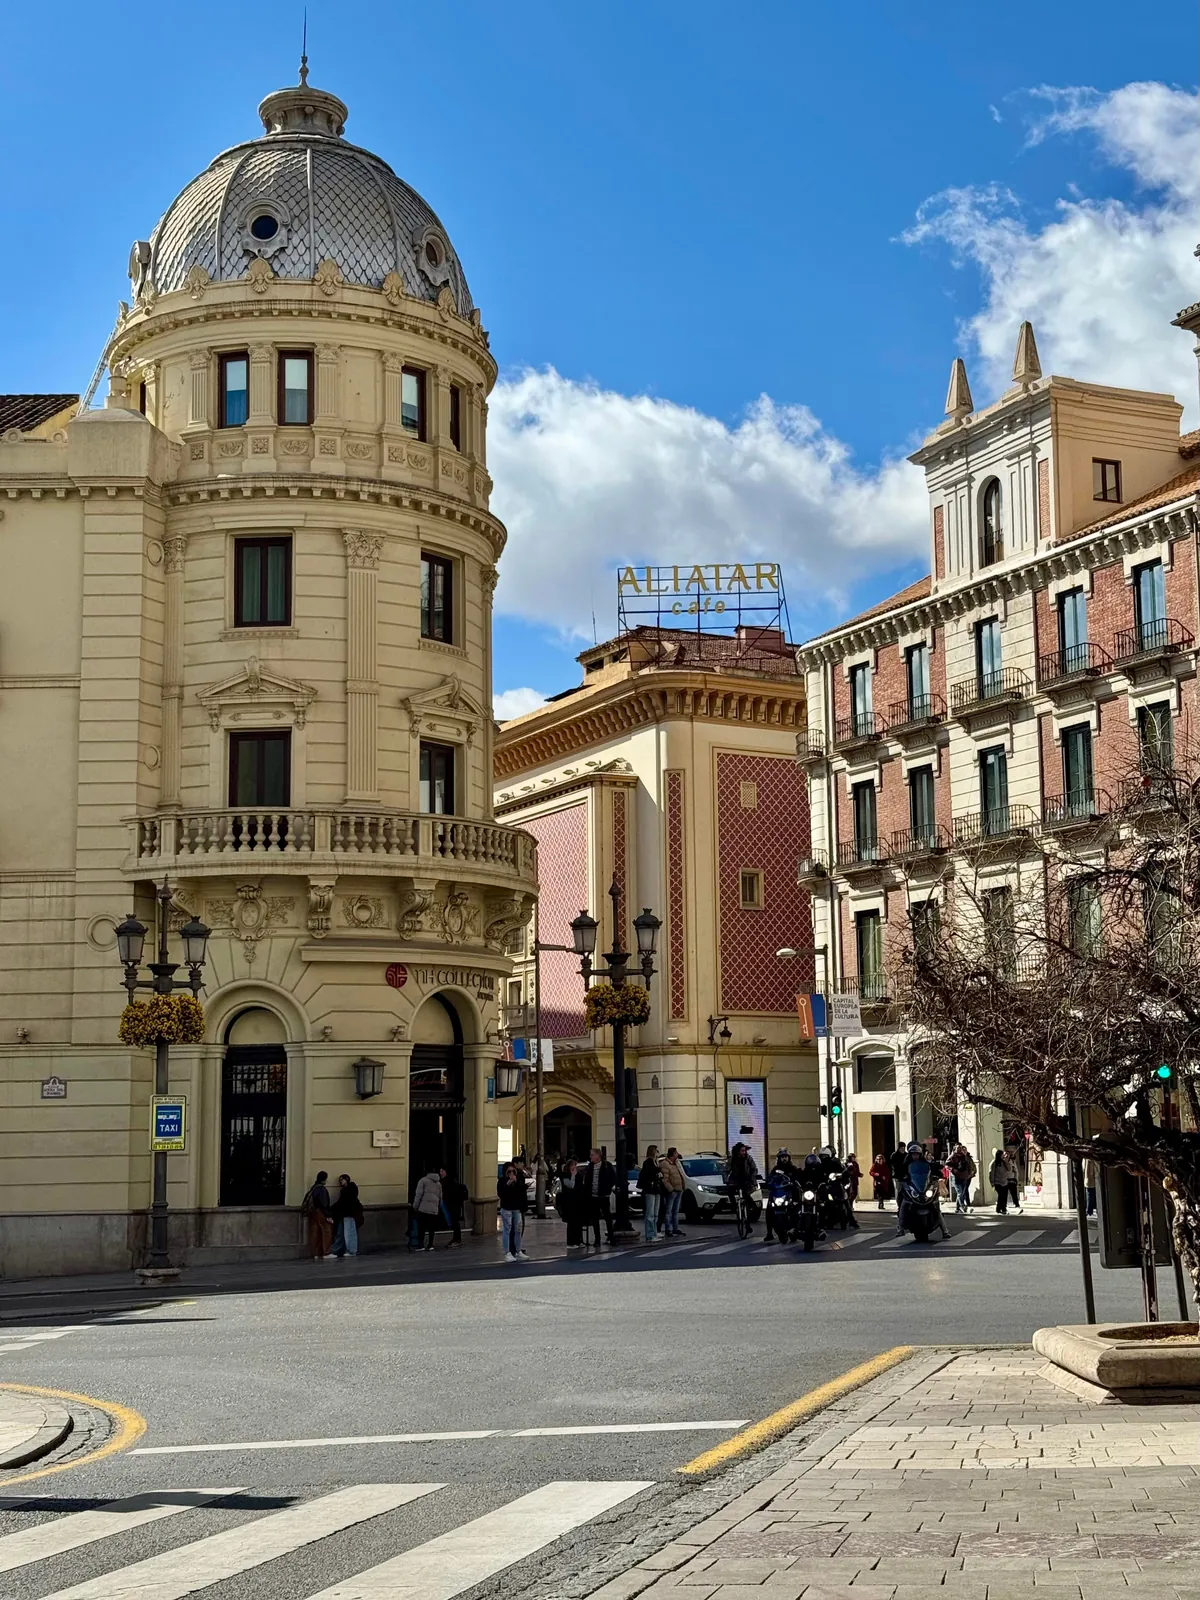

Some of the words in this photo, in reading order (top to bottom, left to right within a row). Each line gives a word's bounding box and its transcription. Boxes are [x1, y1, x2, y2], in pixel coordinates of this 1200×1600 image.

[618, 563, 779, 593] ALIATAR
[671, 597, 726, 615] cafe
[437, 970, 494, 990] COLLECTION
[733, 1094, 754, 1106] Box
[160, 1124, 178, 1132] TAXI
